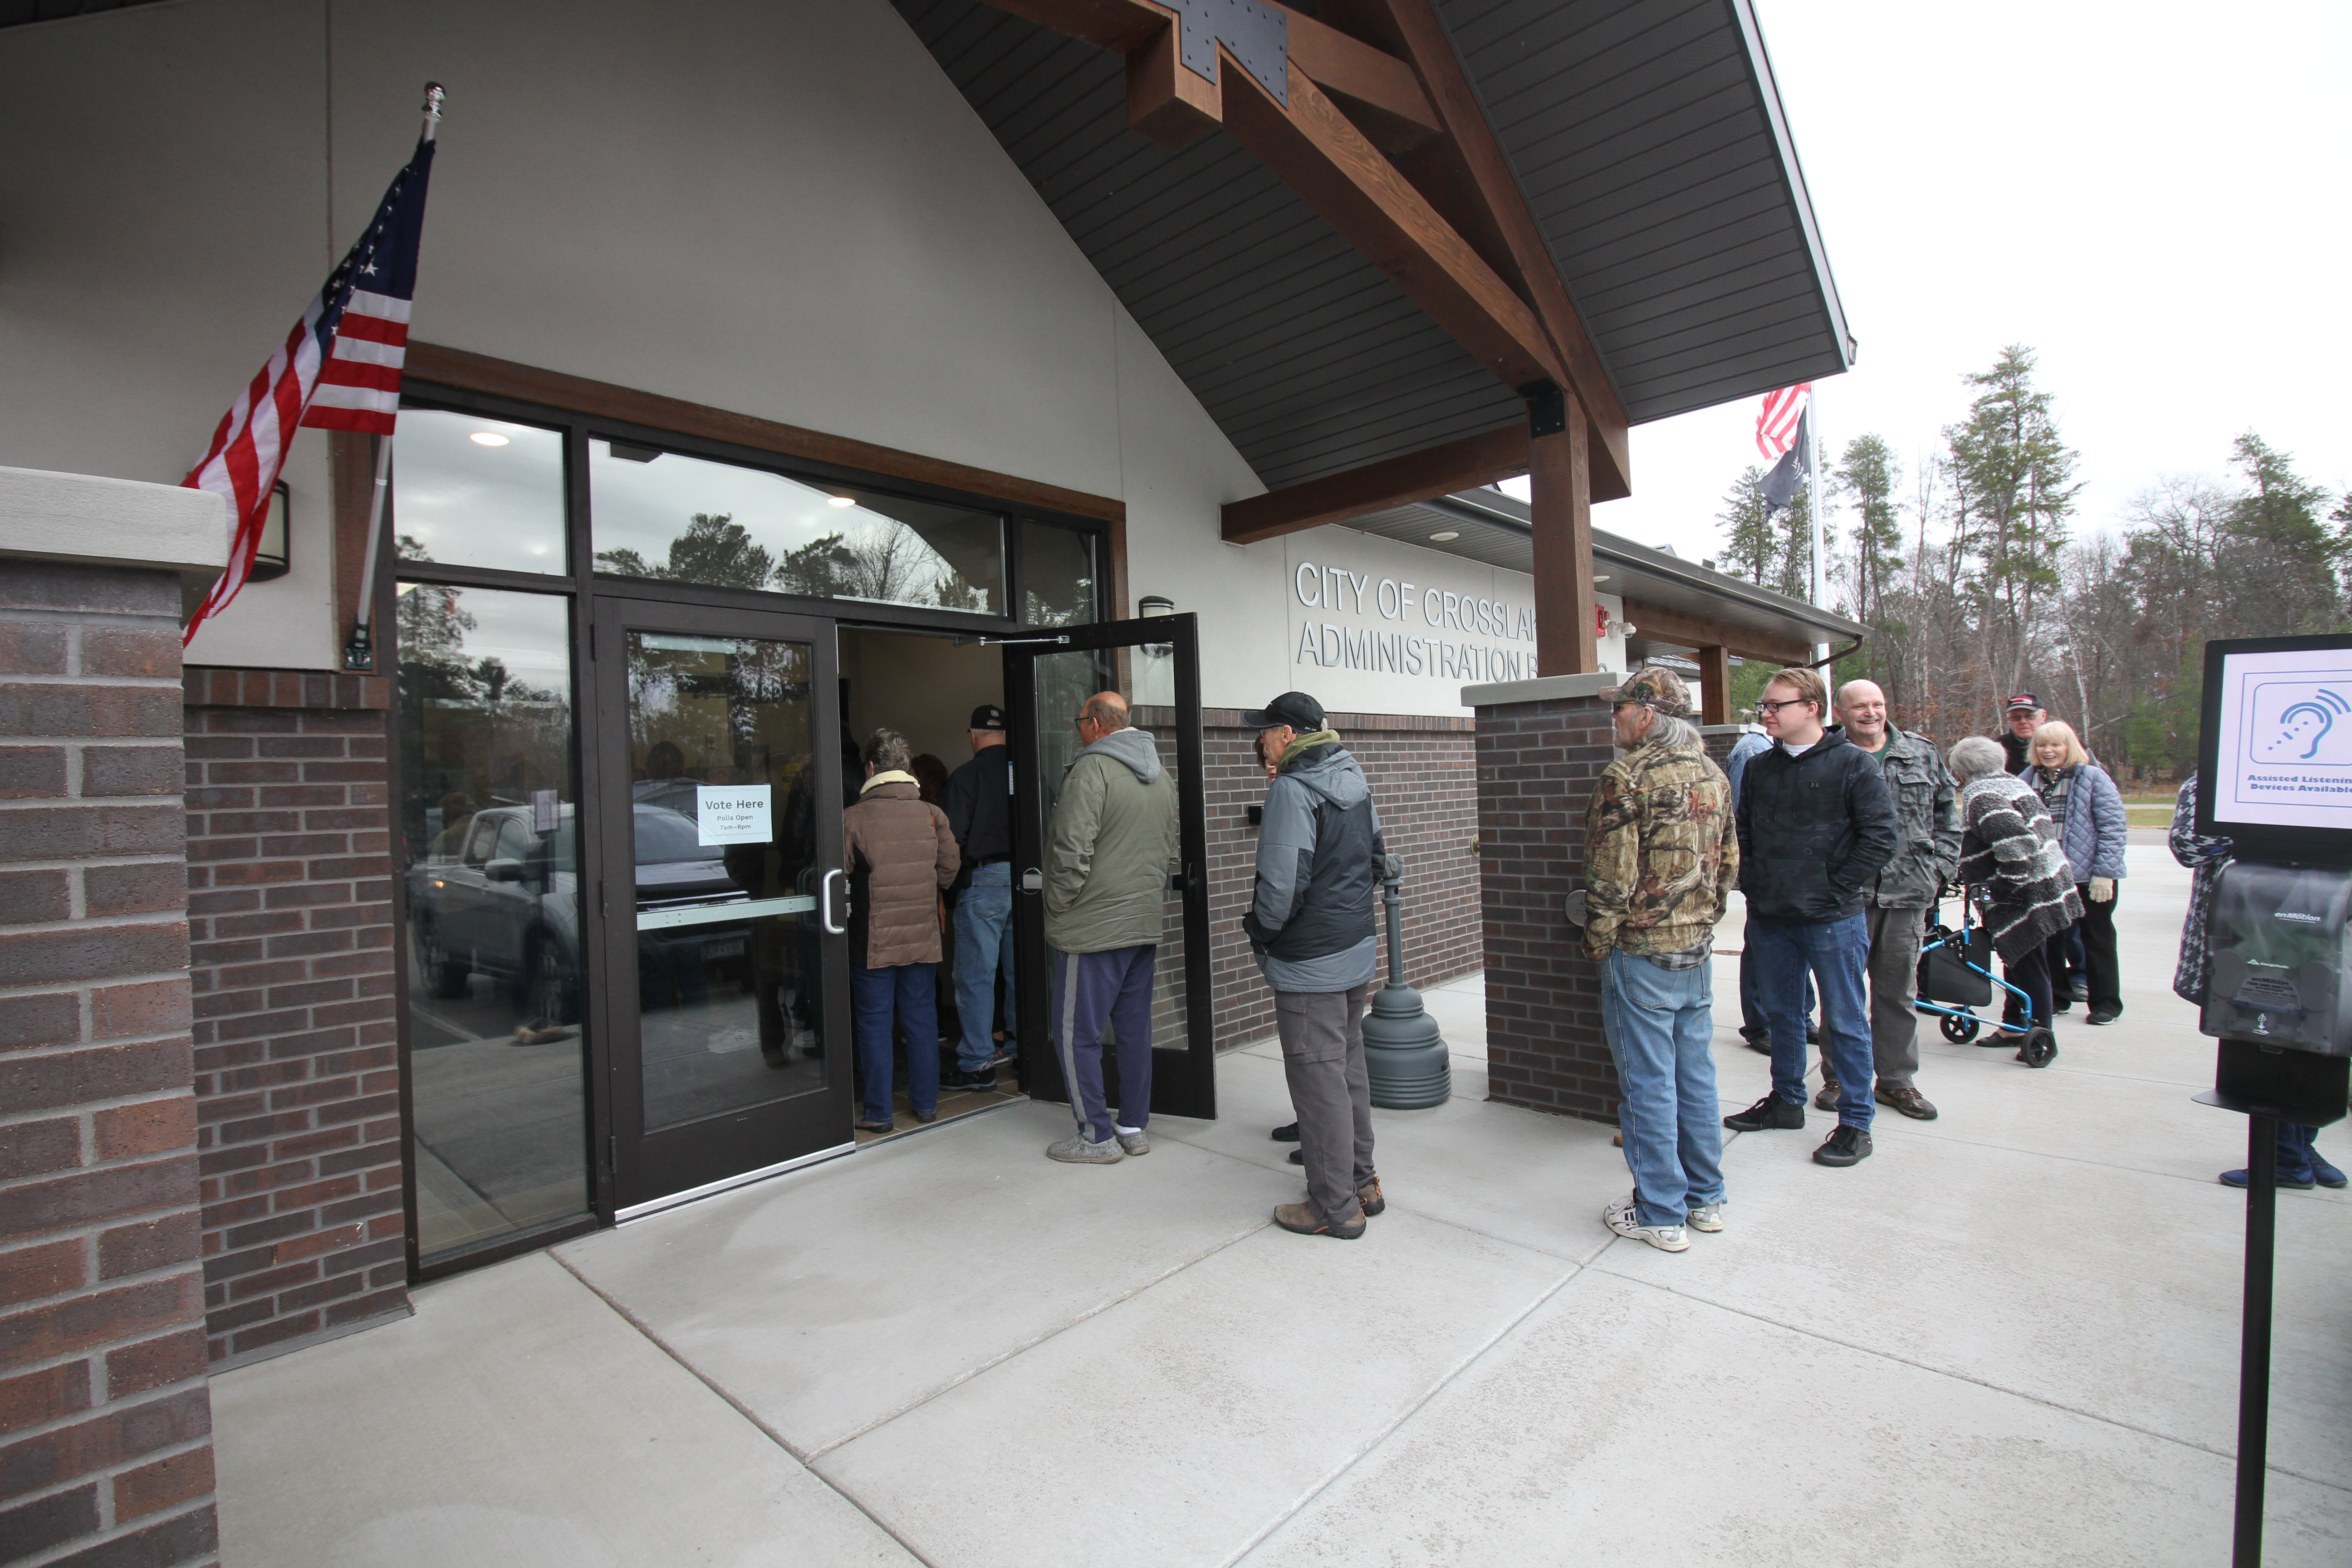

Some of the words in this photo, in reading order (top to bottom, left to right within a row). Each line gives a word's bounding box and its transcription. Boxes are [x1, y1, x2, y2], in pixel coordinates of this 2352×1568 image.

[1296, 562, 1368, 615] CITY
[1377, 578, 1415, 621] OF
[1298, 621, 1520, 682] ADMINISTRATION
[705, 800, 732, 810] Vote
[736, 800, 764, 808] Here
[2274, 912, 2321, 921] enMotion
[2251, 977, 2289, 985] enMotion
